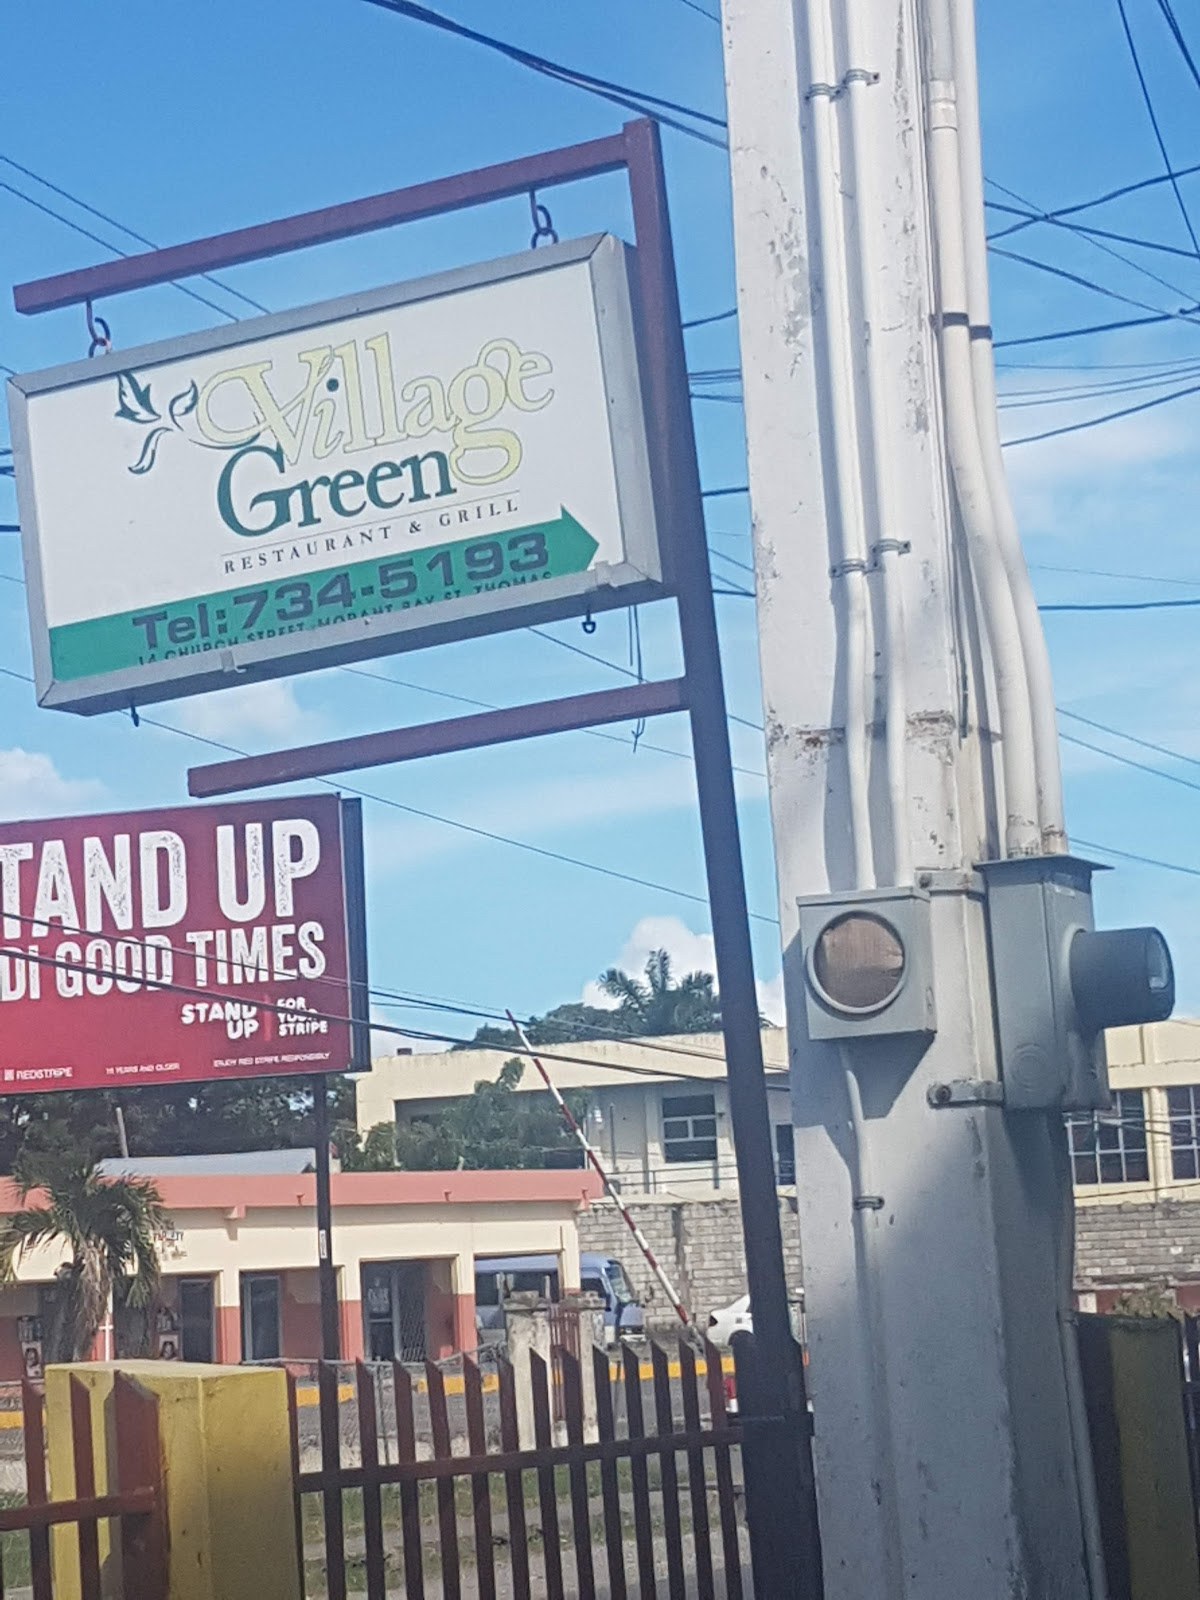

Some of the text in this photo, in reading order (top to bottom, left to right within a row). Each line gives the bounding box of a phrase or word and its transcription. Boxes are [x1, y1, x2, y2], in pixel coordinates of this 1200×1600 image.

[196, 331, 556, 486] Village
[216, 445, 458, 538] Green
[223, 499, 519, 575] RESTAURANT & GRILL
[216, 818, 321, 922] UP
[0, 921, 326, 1002] DI GOOD TIMES
[181, 1001, 257, 1025] STAND
[226, 1019, 260, 1040] UP
[278, 1020, 328, 1037] STRIPE
